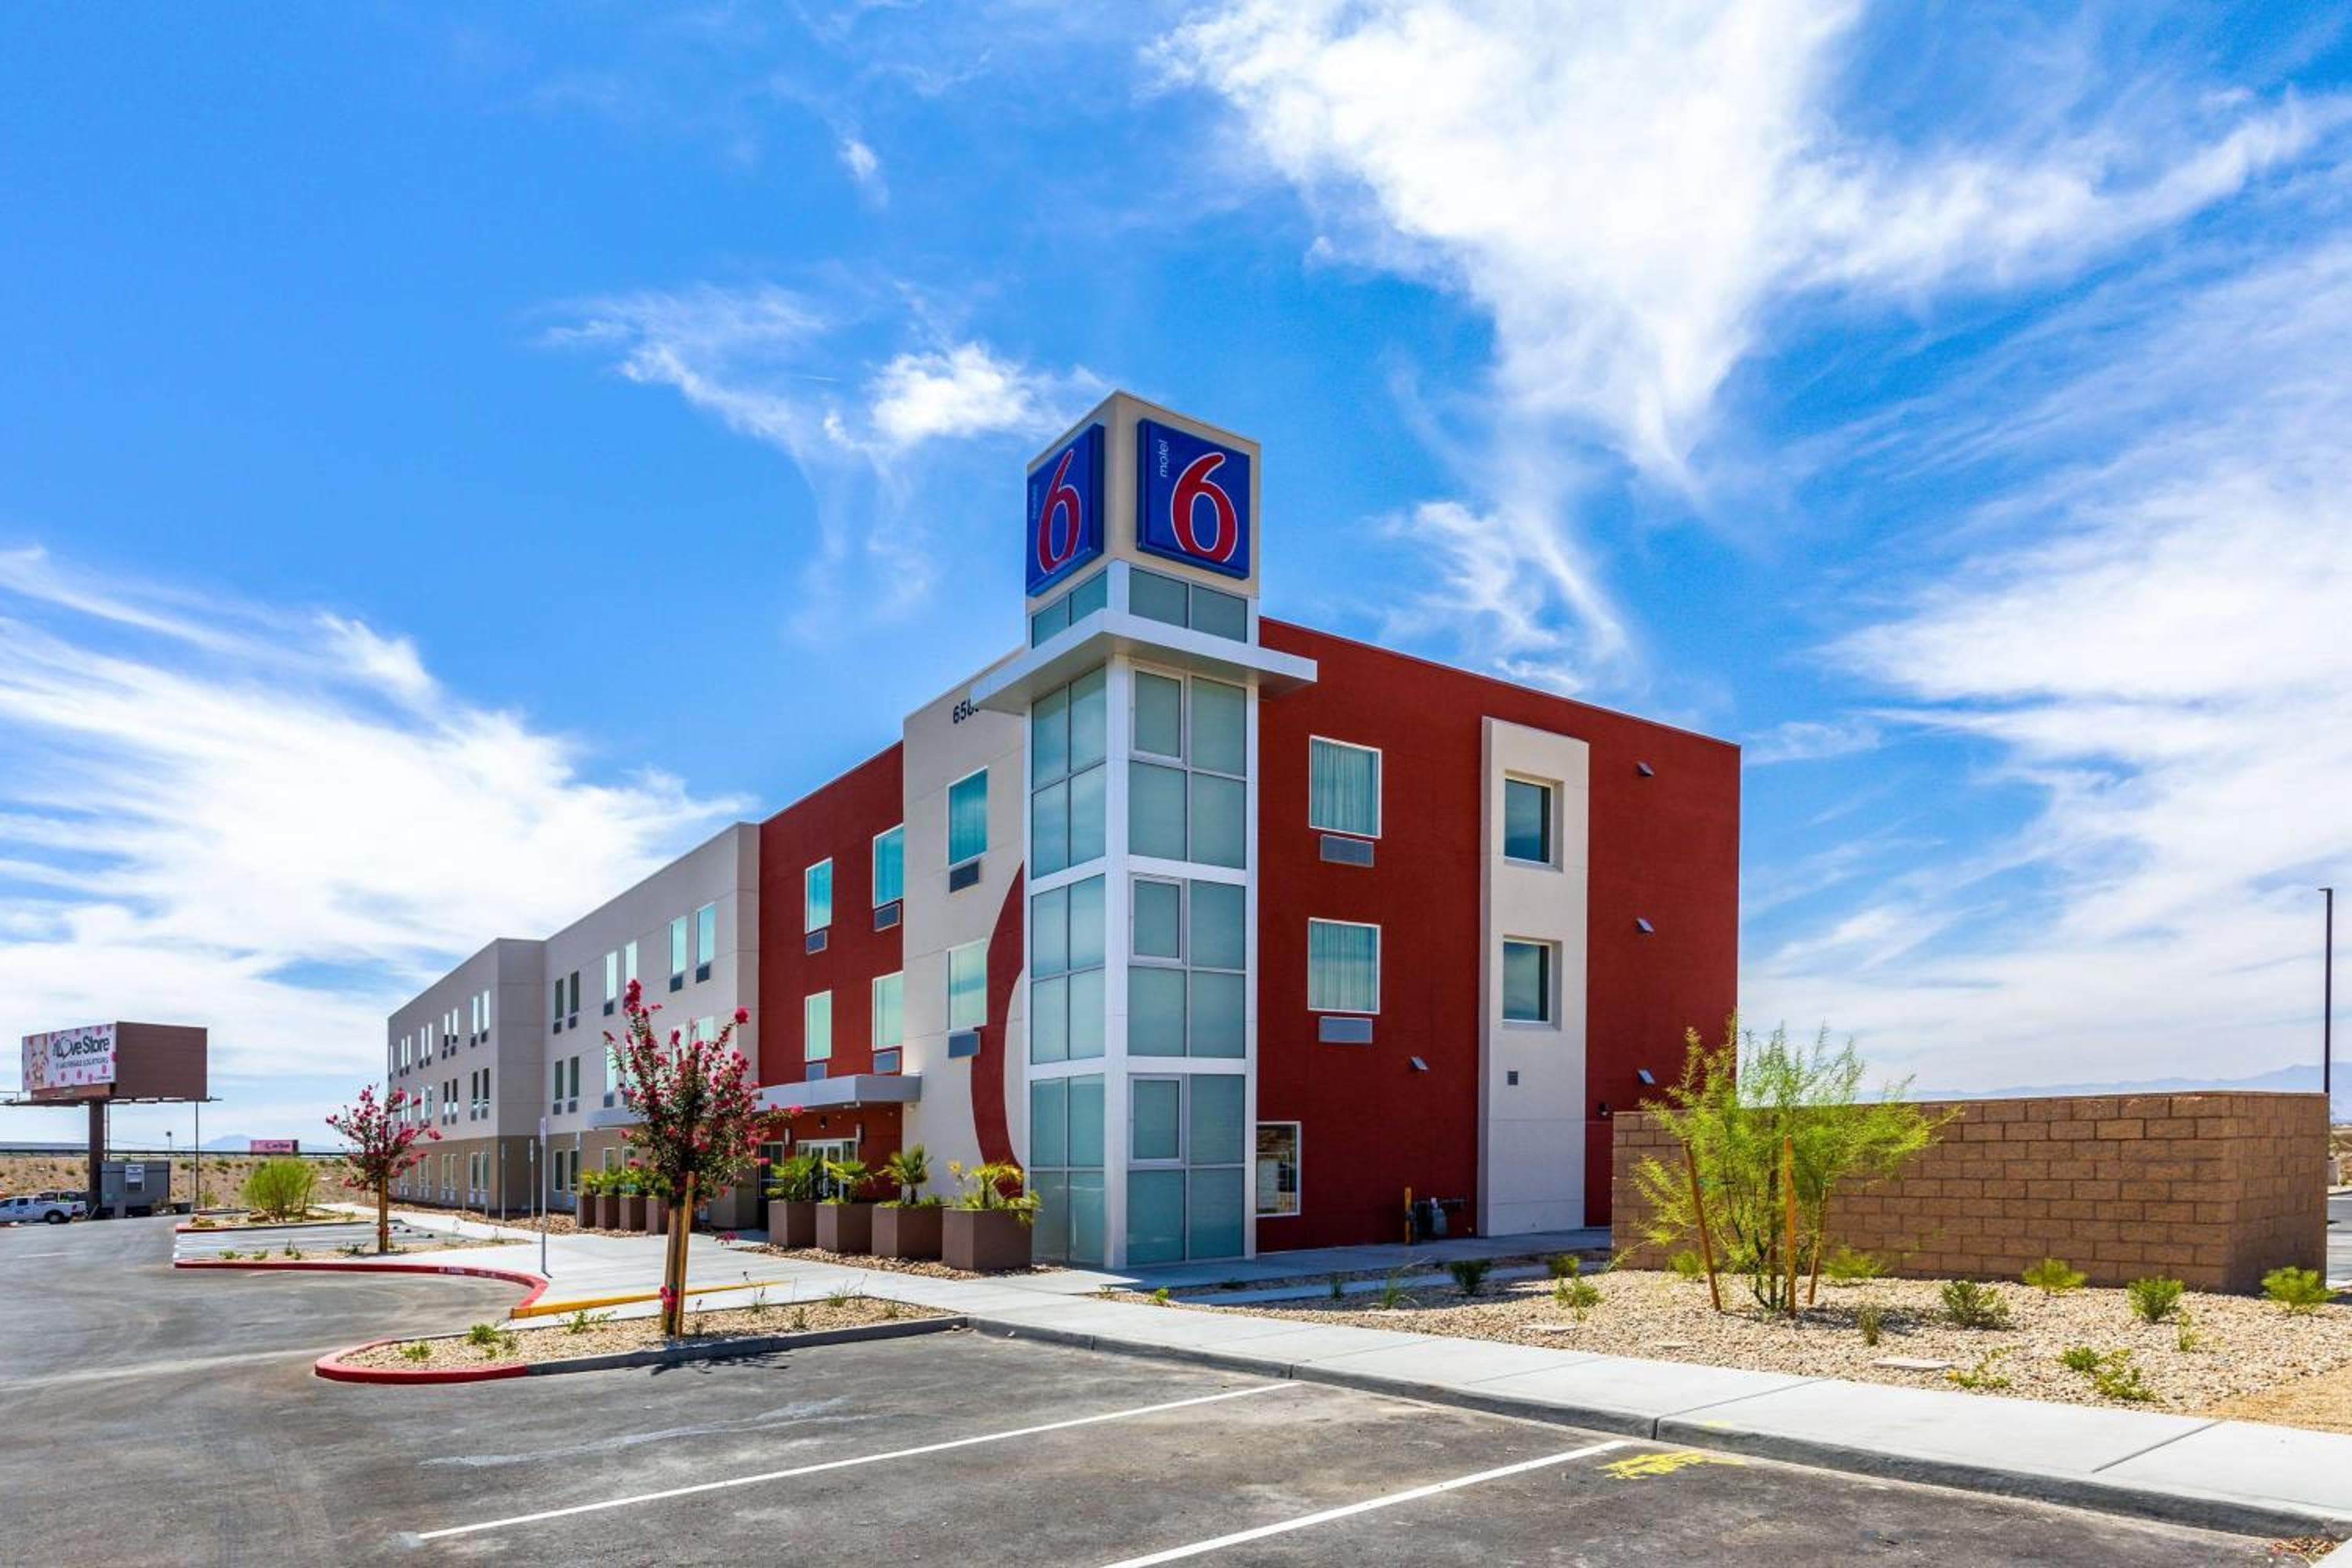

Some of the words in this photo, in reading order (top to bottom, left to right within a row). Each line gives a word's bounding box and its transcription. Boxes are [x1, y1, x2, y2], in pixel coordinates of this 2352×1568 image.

[1158, 439, 1168, 477] motel
[1037, 449, 1081, 575] 6
[1171, 452, 1237, 562] 6
[953, 697, 979, 724] 658
[83, 1035, 110, 1054] Store
